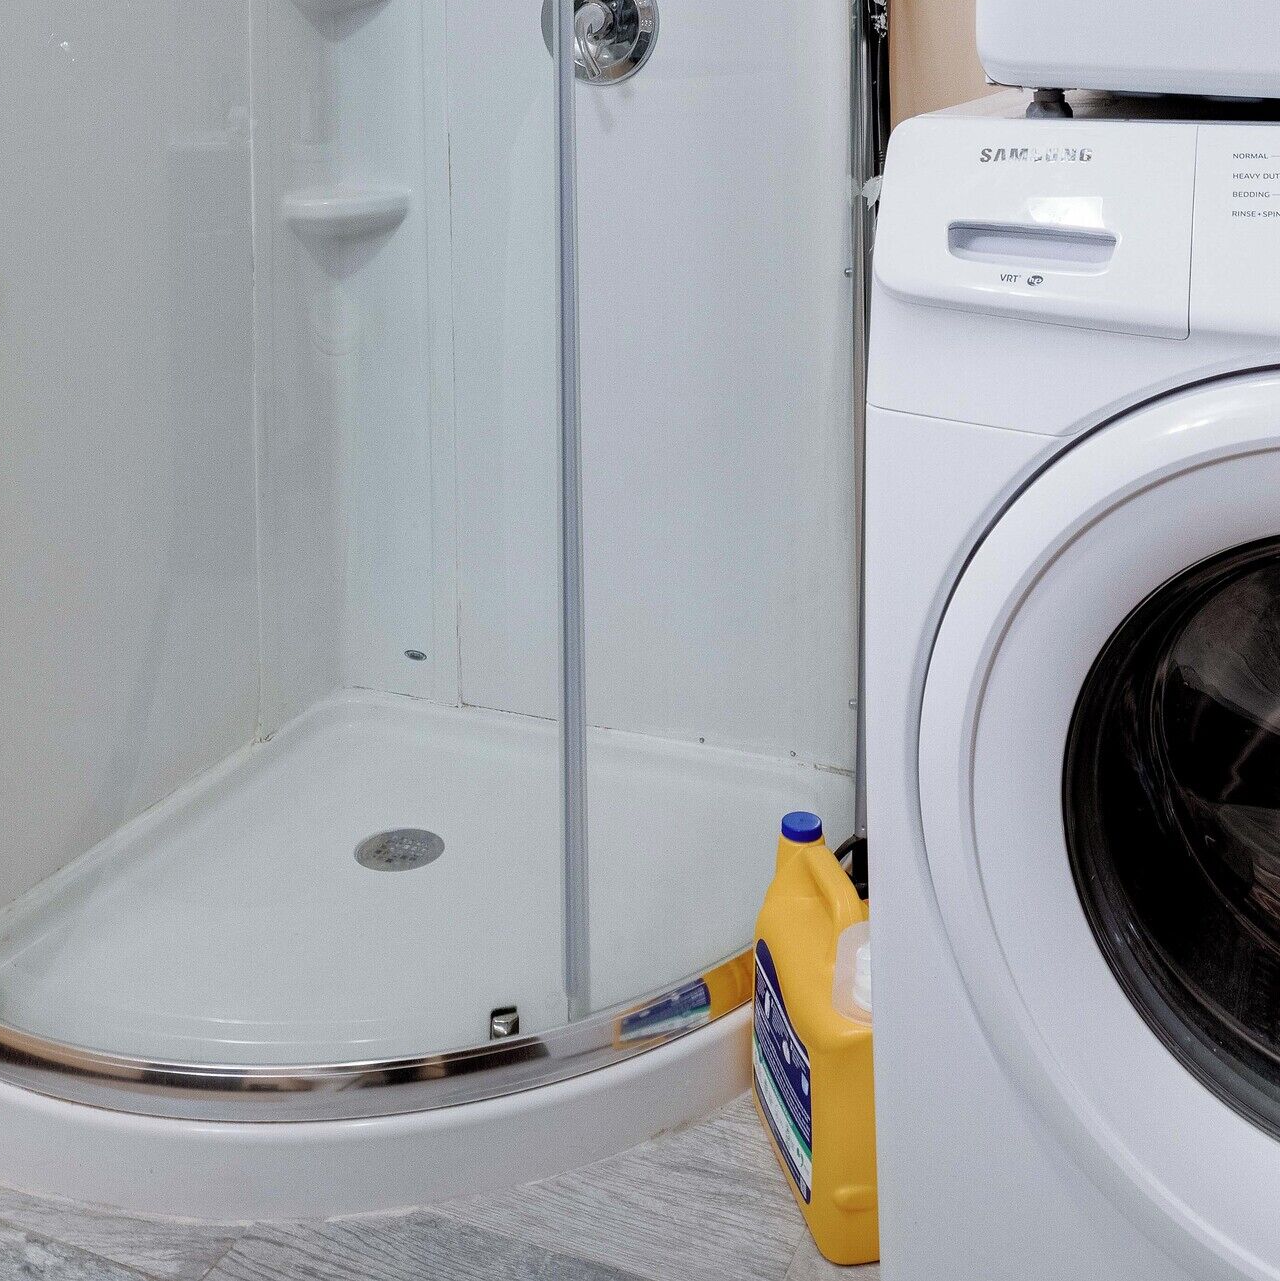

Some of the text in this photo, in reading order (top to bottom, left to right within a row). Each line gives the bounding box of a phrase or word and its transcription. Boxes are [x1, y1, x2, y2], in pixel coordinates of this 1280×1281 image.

[1232, 152, 1269, 160] NORMAL
[1232, 172, 1261, 180] HEAVY
[1232, 190, 1271, 198] BEDDING
